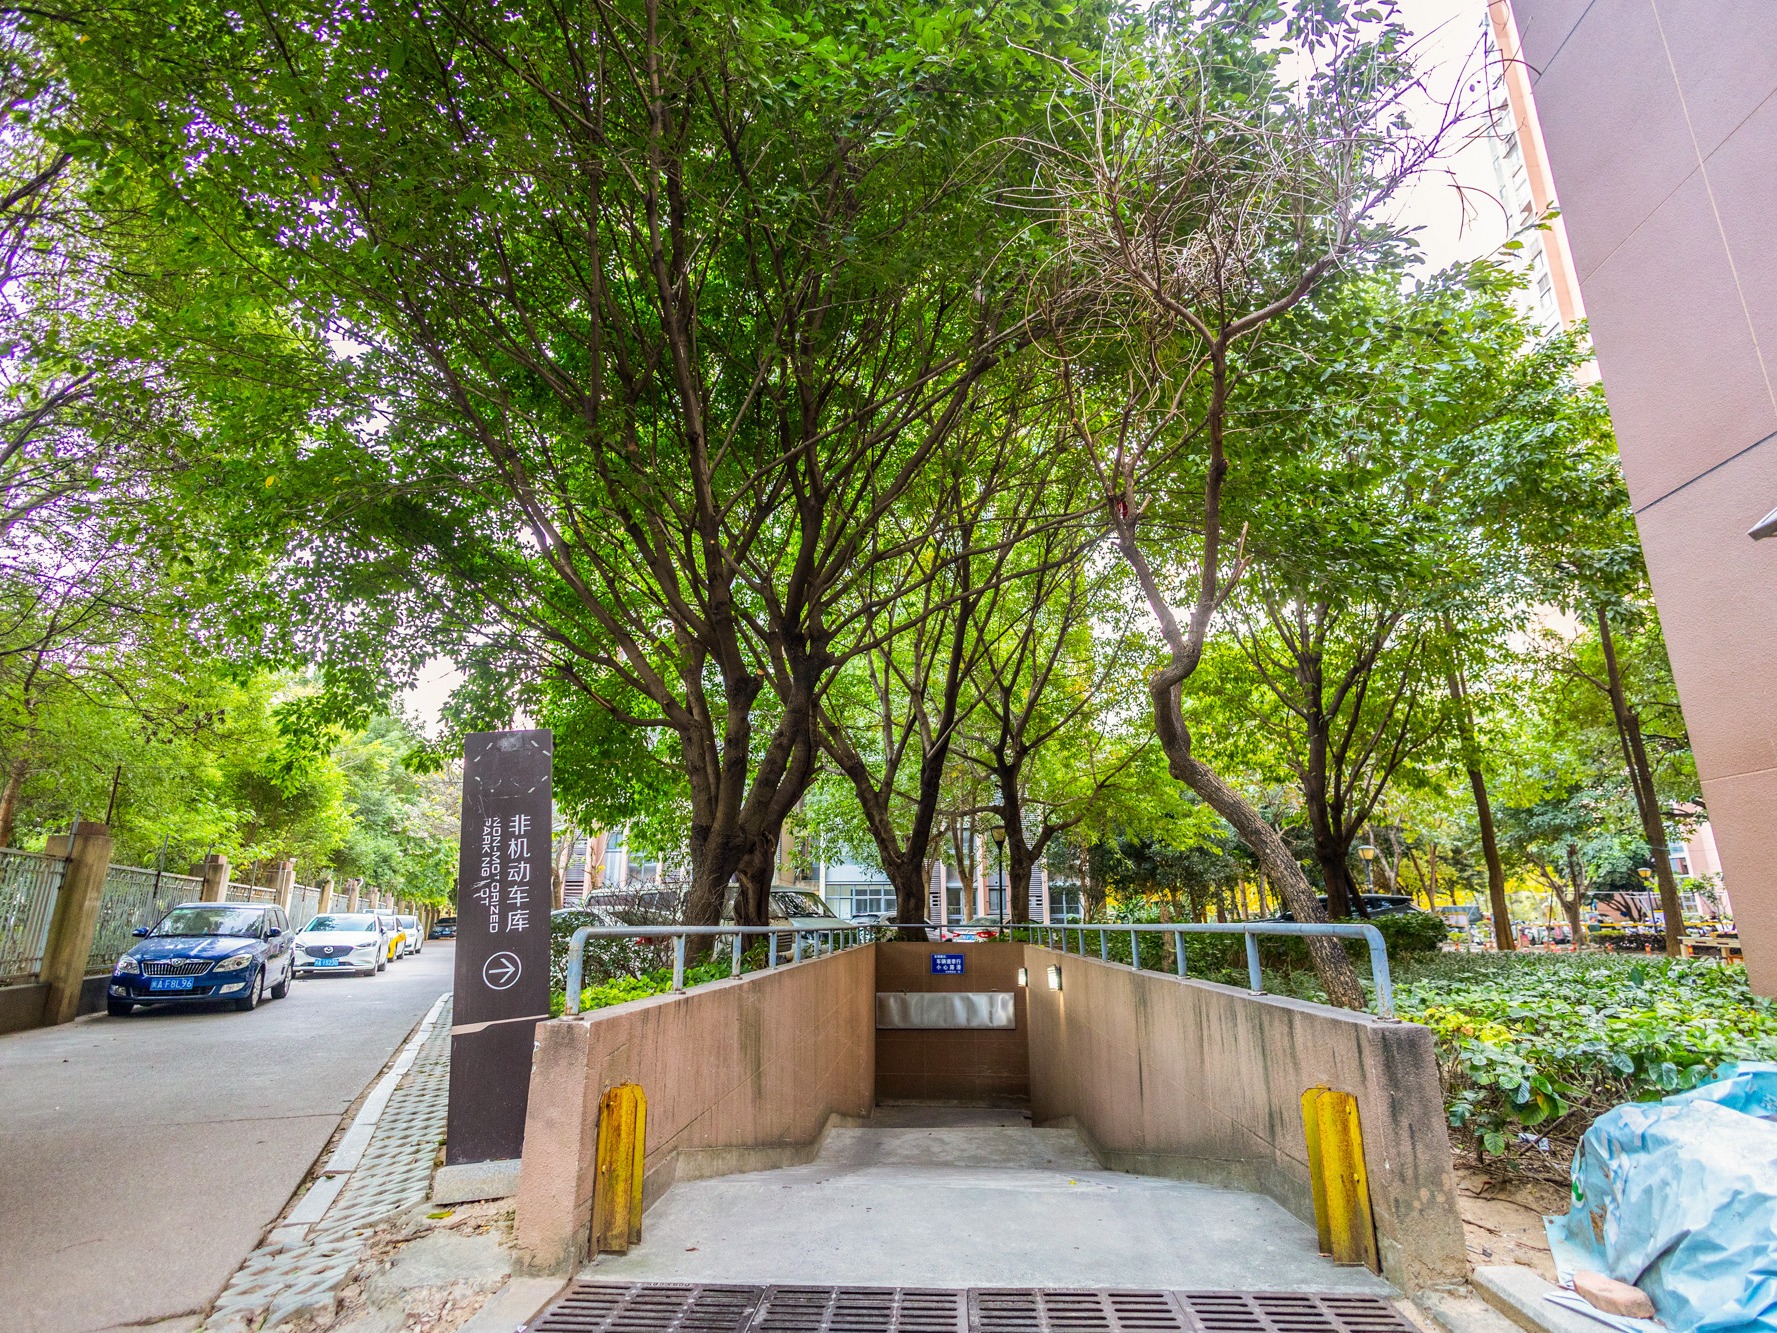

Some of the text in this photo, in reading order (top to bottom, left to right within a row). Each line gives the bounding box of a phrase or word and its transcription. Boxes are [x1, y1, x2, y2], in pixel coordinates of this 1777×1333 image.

[481, 818, 492, 877] PARKNG
[506, 814, 531, 932] 非机动车库
